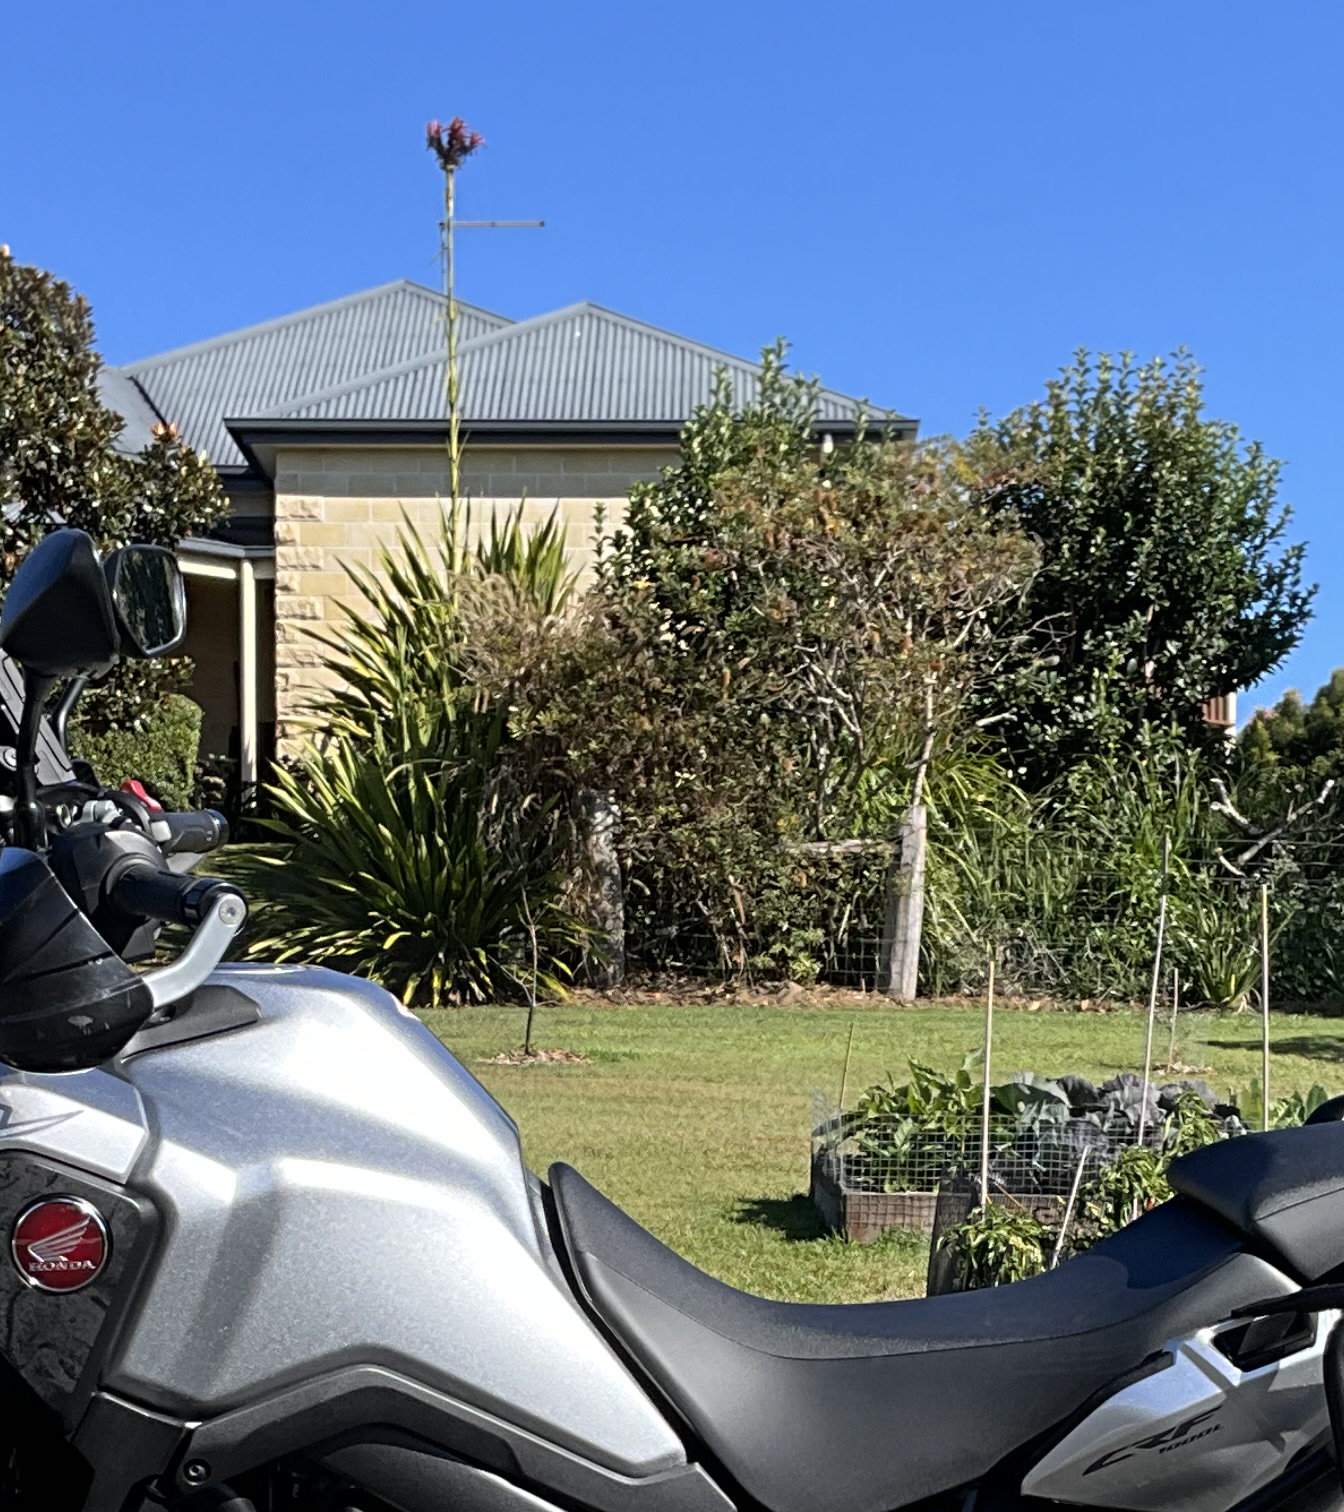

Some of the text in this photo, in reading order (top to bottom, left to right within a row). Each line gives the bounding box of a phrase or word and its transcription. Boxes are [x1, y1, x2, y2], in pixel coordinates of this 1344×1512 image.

[29, 1260, 97, 1272] HONDA
[1082, 1405, 1224, 1476] CRF
[1159, 1423, 1223, 1454] 1000L
